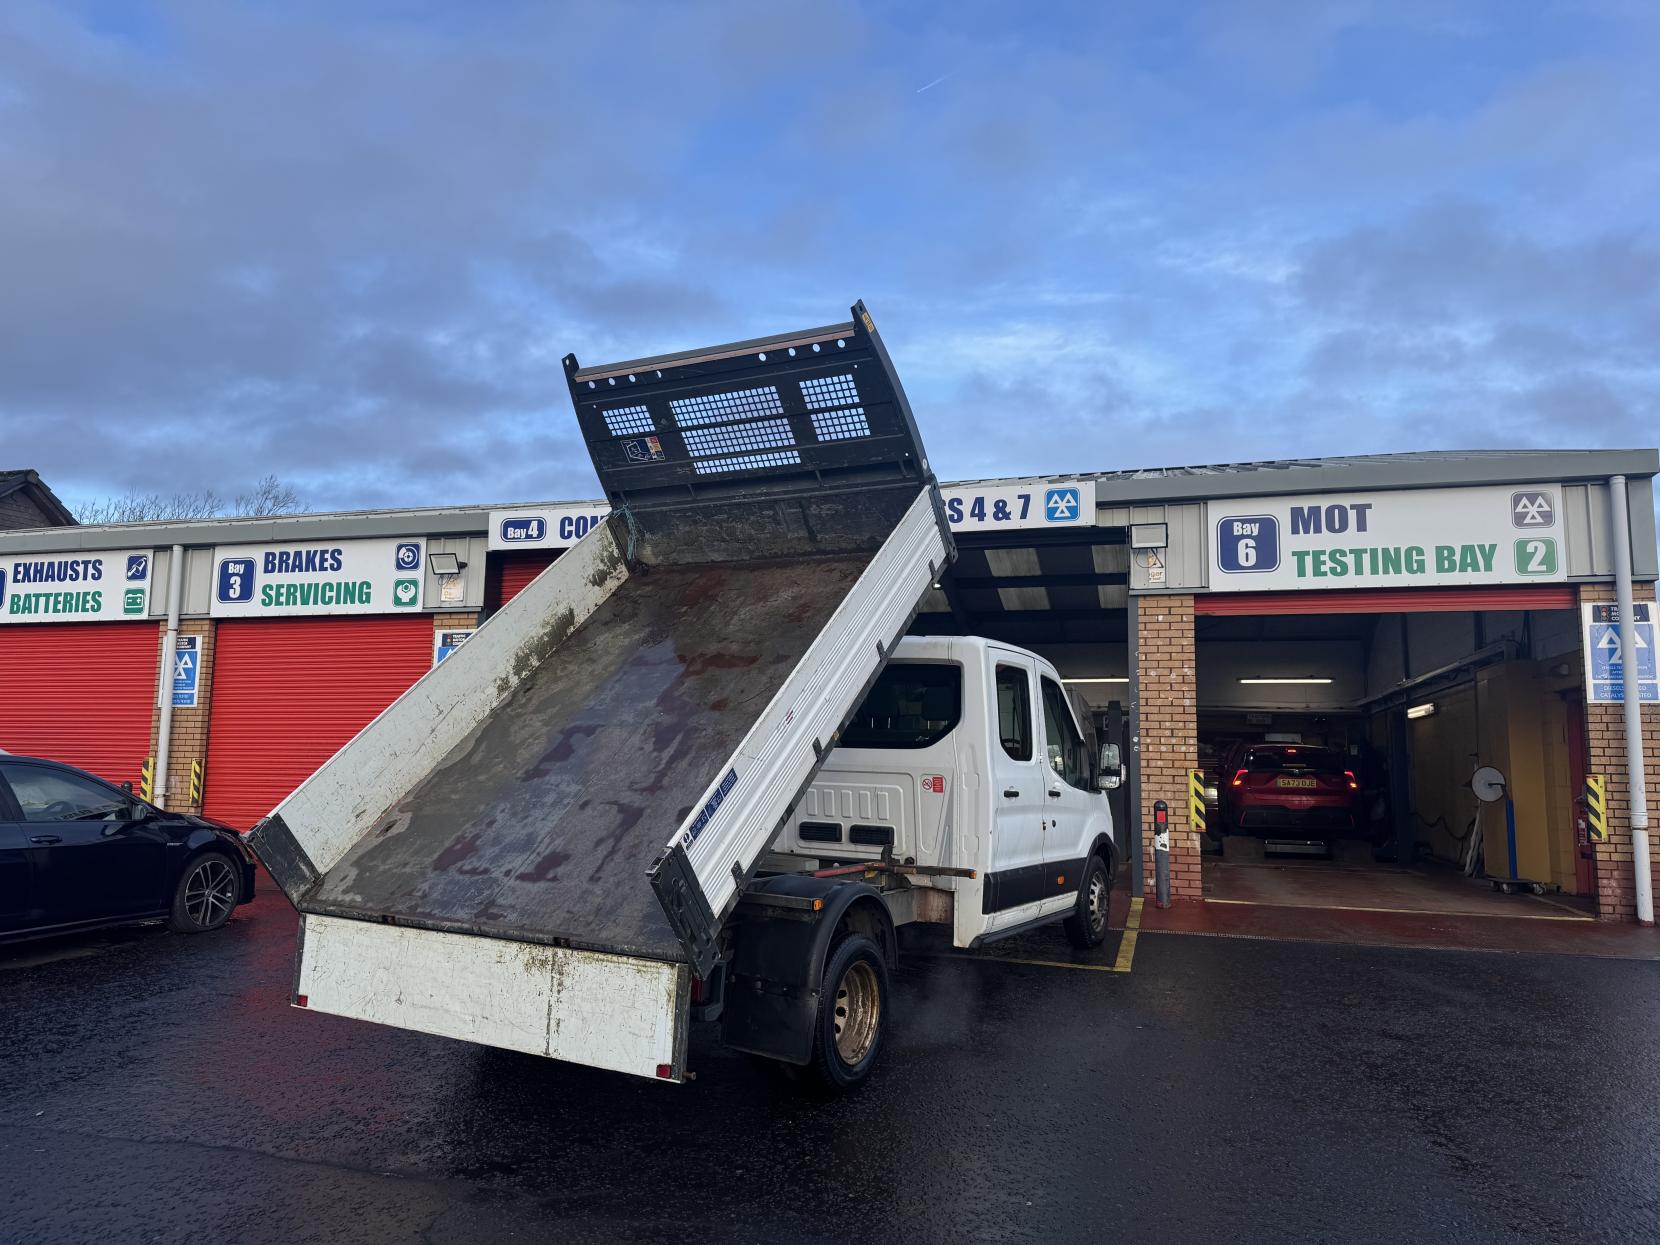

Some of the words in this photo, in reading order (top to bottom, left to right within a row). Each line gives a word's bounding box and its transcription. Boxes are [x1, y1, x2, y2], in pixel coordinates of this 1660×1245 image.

[943, 497, 964, 523] S
[970, 496, 987, 522] 4
[993, 499, 1012, 522] &
[1017, 493, 1031, 520] 7
[1290, 503, 1373, 535] MOT
[507, 527, 527, 539] Bay
[528, 520, 539, 538] 4
[1233, 521, 1260, 537] Bay
[263, 548, 343, 574] BRAKES
[1237, 538, 1257, 567] 6
[1291, 545, 1426, 578] TESTING
[1435, 543, 1498, 574] BAY
[1526, 540, 1547, 572] 2
[12, 559, 103, 584] EXHAUSTS
[228, 562, 245, 574] Bay
[228, 575, 242, 599] 3
[261, 580, 372, 607] SERVICING
[9, 590, 103, 615] BATTERIES
